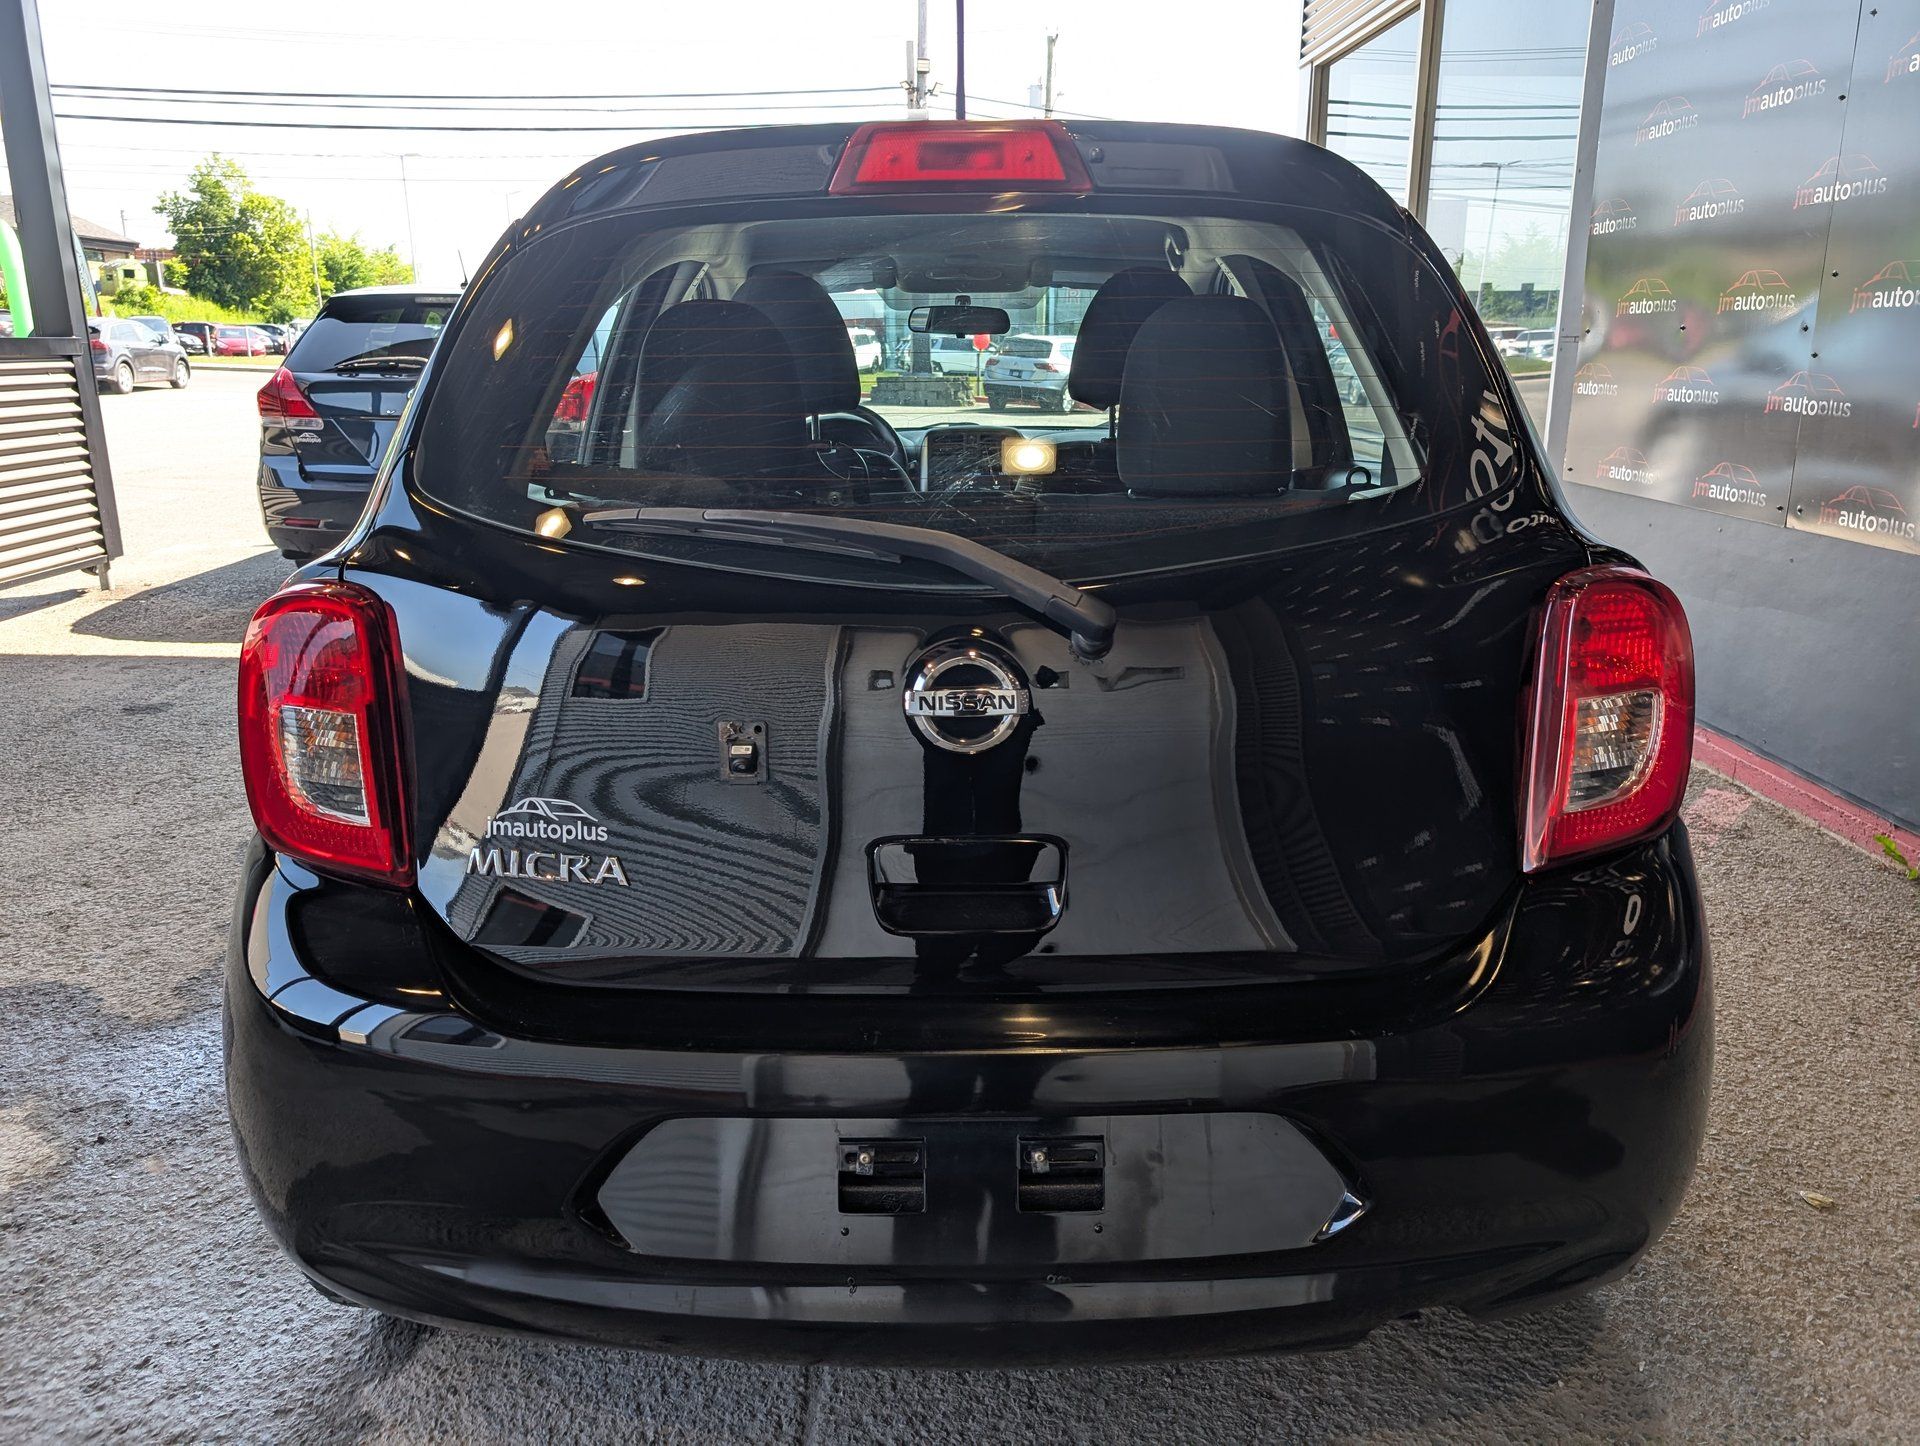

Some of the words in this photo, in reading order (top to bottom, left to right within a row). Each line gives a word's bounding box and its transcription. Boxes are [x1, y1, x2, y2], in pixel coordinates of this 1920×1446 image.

[1742, 79, 1826, 119] jmautoplus
[1635, 114, 1698, 146] jmautoplus
[1793, 177, 1887, 209] jmautoplus
[1674, 199, 1744, 226] jmautoplus
[1616, 298, 1677, 318] jmautoplus
[1717, 292, 1796, 315] jmautoplus
[1653, 384, 1719, 404] jmautoplus
[1764, 391, 1851, 418] jmautoplus
[1692, 477, 1767, 508] jmautoplus
[1818, 501, 1915, 539] jmautoplus
[918, 694, 1016, 712] NISSAN
[485, 816, 609, 842] jmautoplus
[466, 847, 630, 887] MICRA
